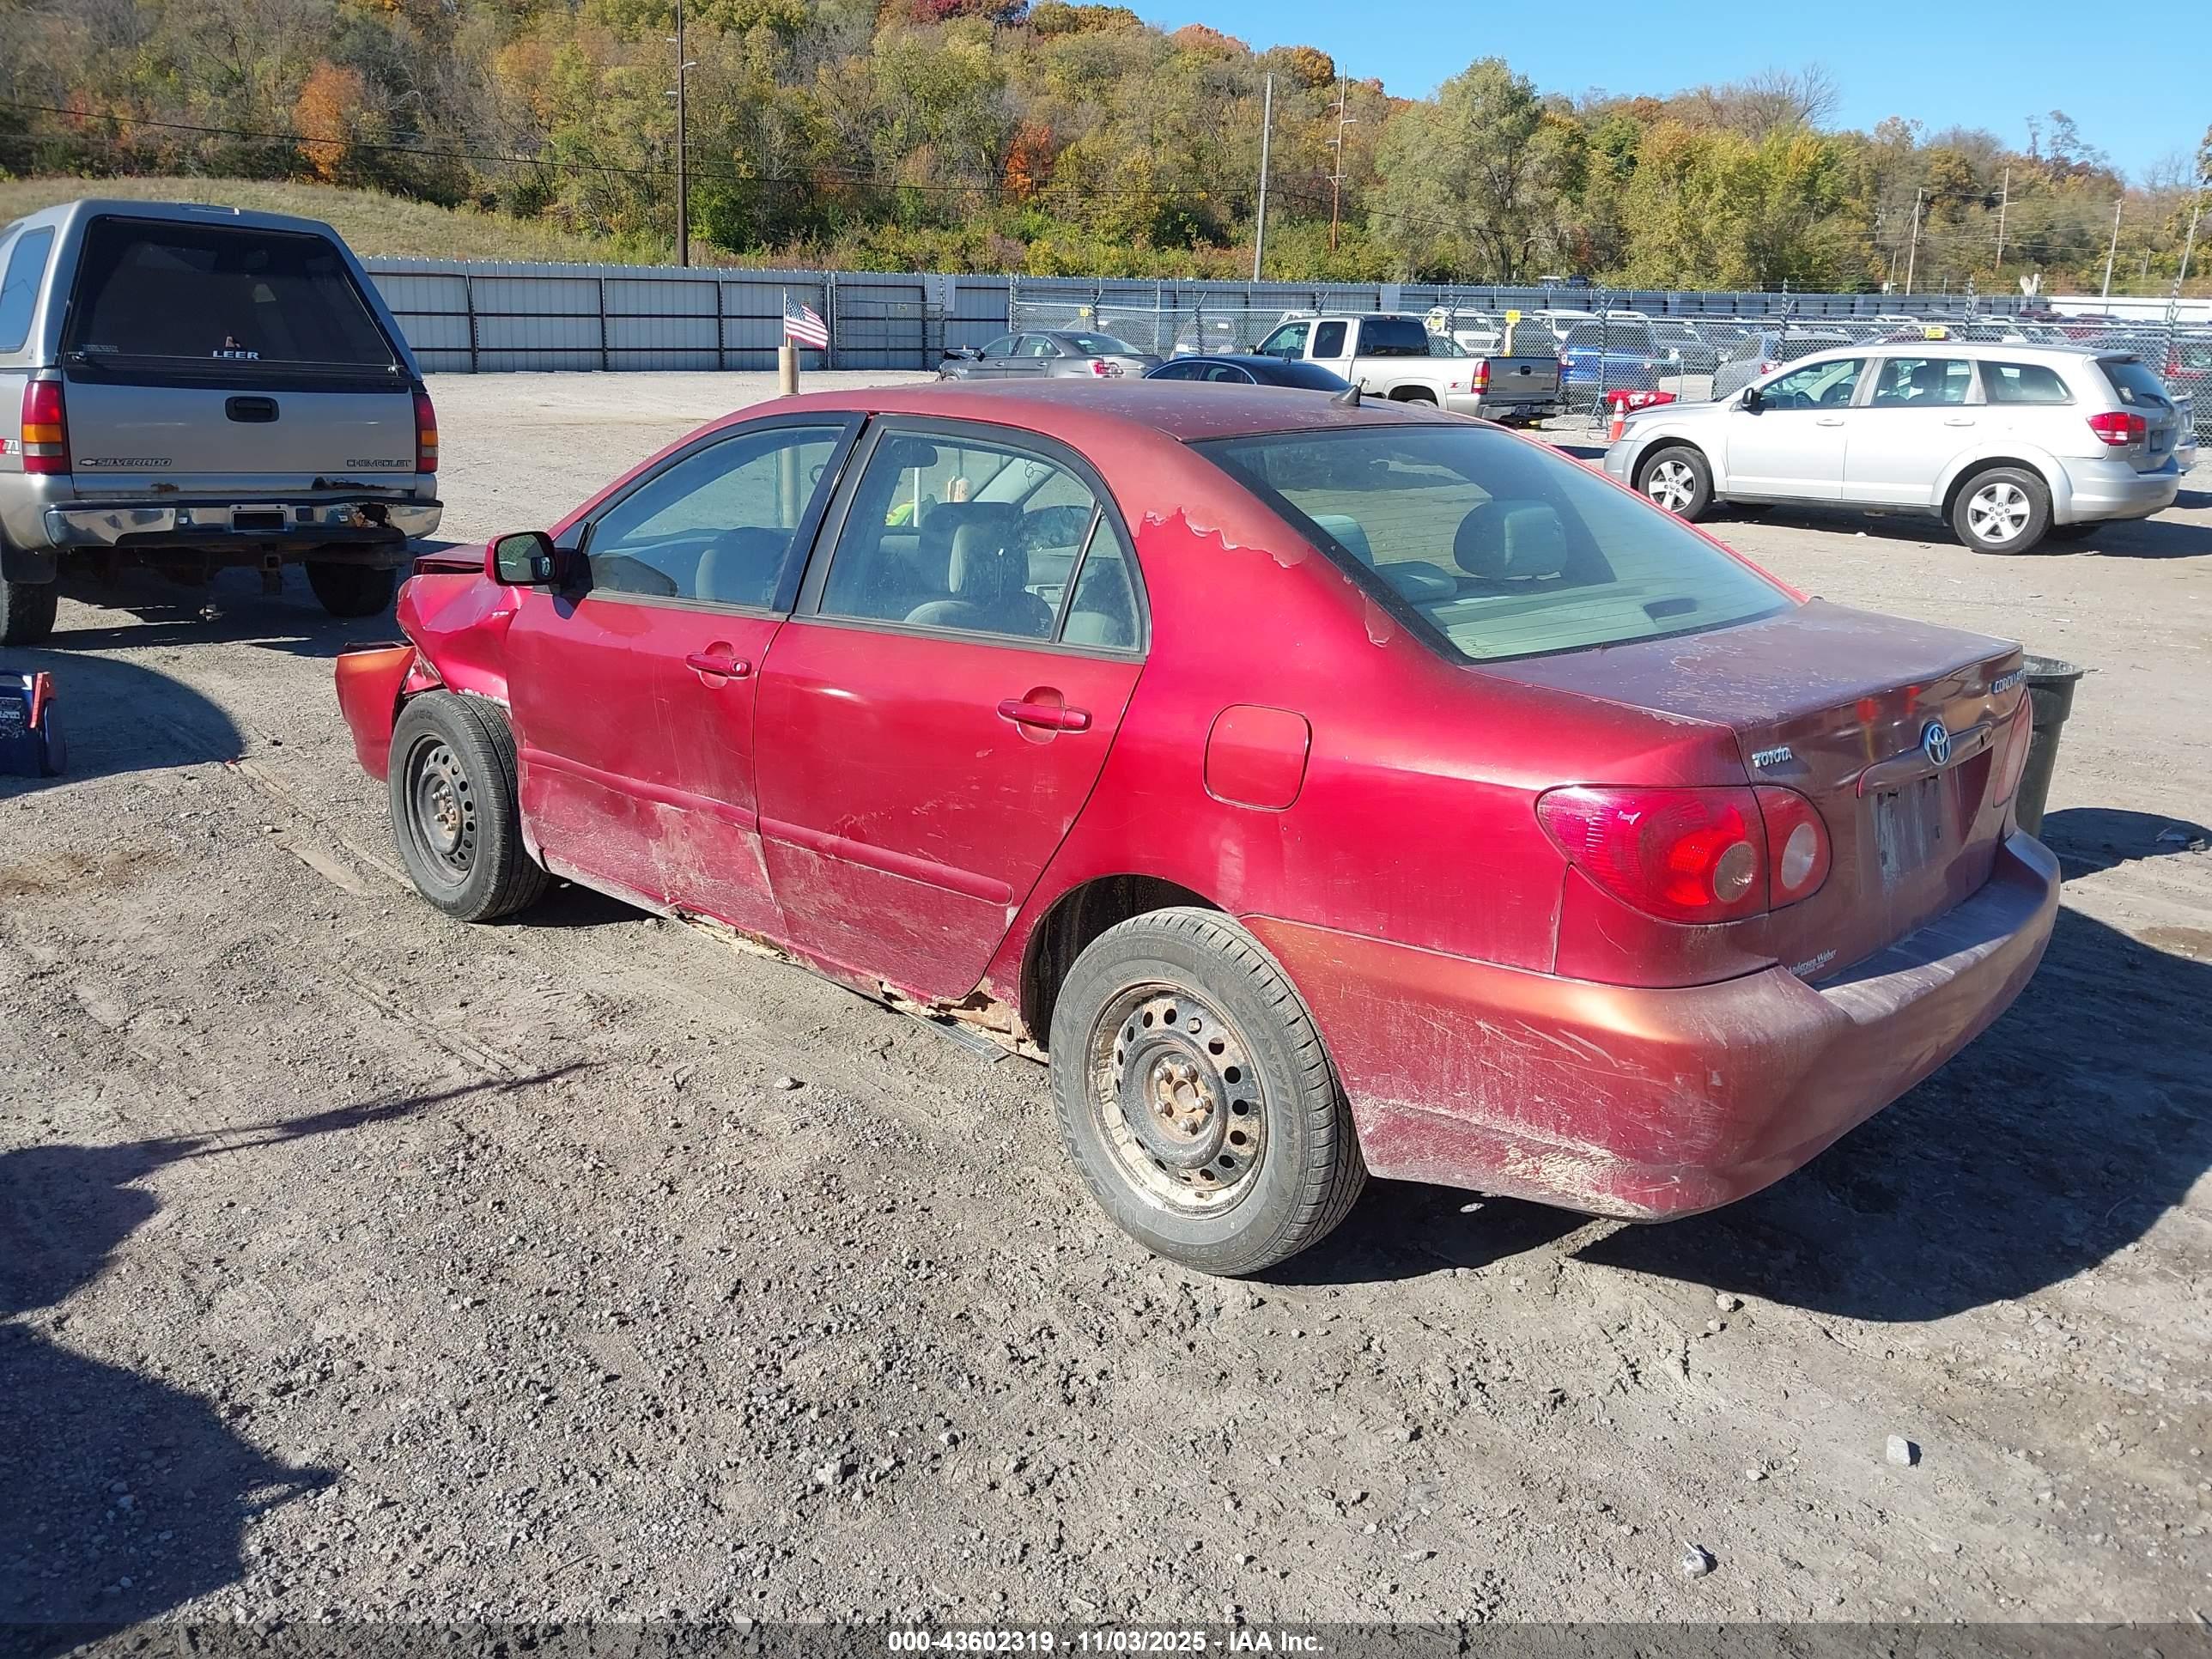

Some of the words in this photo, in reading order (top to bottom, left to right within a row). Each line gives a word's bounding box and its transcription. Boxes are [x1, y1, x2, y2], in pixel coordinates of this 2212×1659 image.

[212, 350, 260, 361] LEER
[96, 458, 172, 467] SILVERADO
[346, 459, 412, 468] CHEVROLET
[1752, 746, 1793, 769] TOYOTA
